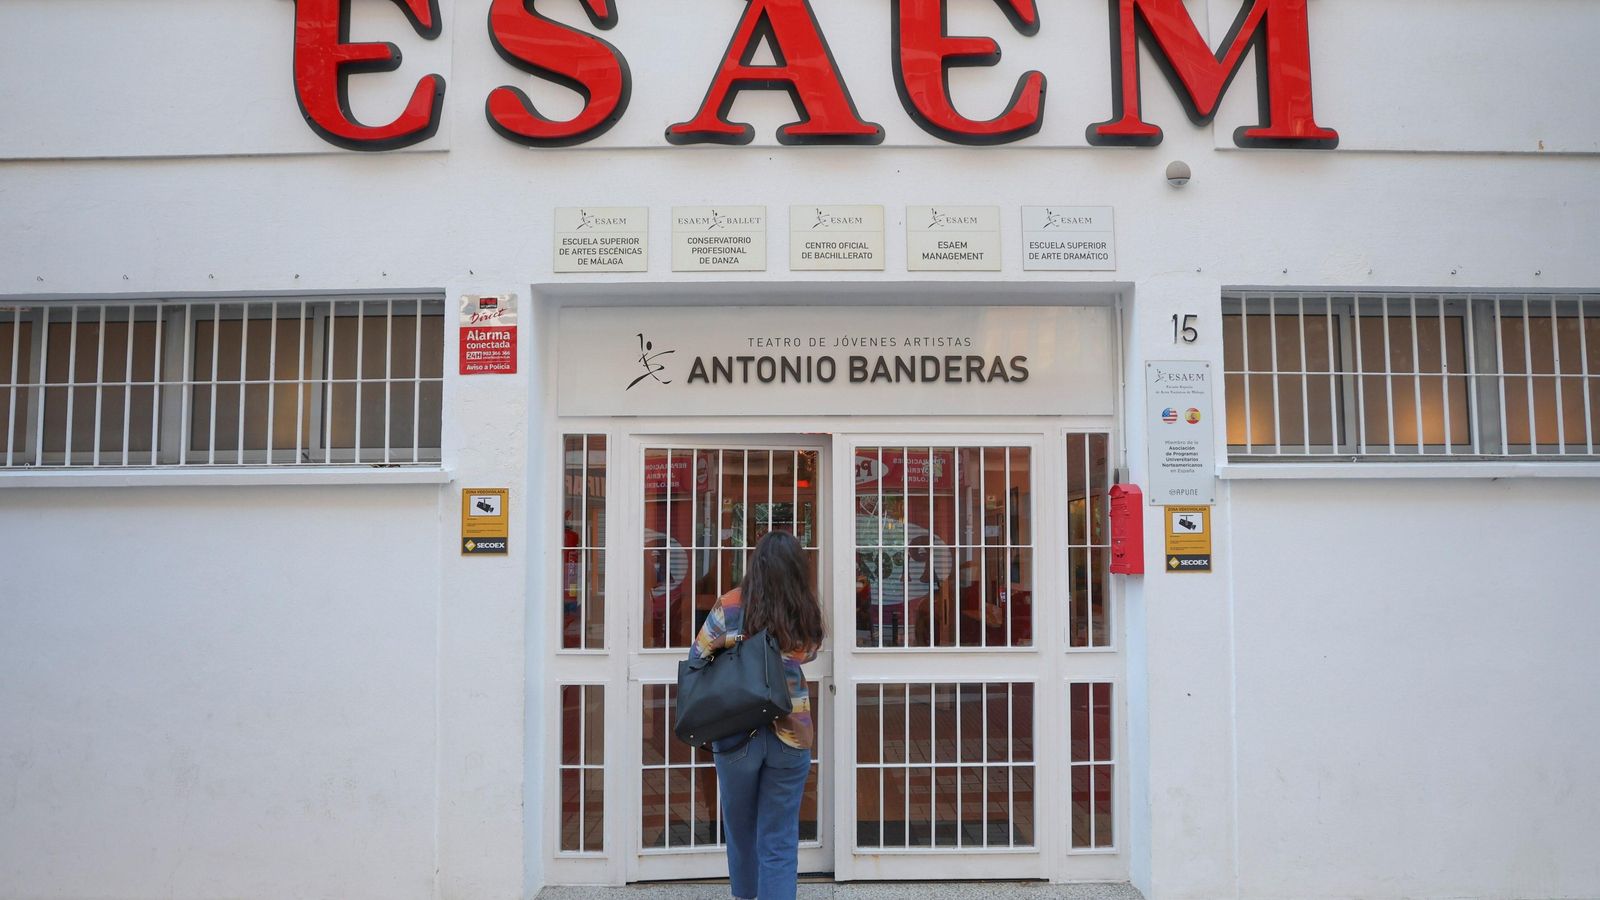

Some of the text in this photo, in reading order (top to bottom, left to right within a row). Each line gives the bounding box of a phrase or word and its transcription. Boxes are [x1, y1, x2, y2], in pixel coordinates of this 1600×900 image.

[294, 0, 1338, 151] ESAEM
[594, 217, 627, 225] ESAEM
[677, 217, 762, 225] ESAEM BALLET
[830, 216, 863, 224] ESAEM
[946, 216, 978, 224] ESAEM
[1061, 216, 1092, 224] ESAEM
[562, 237, 640, 246] ESCUELA SUPERIOR
[687, 236, 752, 245] CONSERVATORIO
[805, 241, 869, 249] CENTRO OFICIAL
[937, 241, 968, 249] ESAEM
[1029, 241, 1107, 249] ESCUELA SUPERIOR
[559, 248, 570, 256] DE
[598, 246, 643, 255] ESCÉNICAS
[691, 246, 747, 254] PROFESIONAL
[801, 251, 873, 260] DE BACHILLERATO
[922, 251, 984, 260] MANAGEMENT
[1028, 250, 1109, 260] DE ARTE DRAMÁTICO
[590, 256, 624, 265] MÁLAGA
[699, 256, 740, 264] DE DANZA
[1172, 313, 1198, 344] 15
[466, 330, 511, 341] Alarma
[748, 334, 972, 347] TEATRO DE JÓVENES ARTISTAS
[466, 341, 511, 349] conectada
[687, 354, 1030, 385] ANTONIO BANDERAS
[1168, 373, 1205, 381] ESAEM
